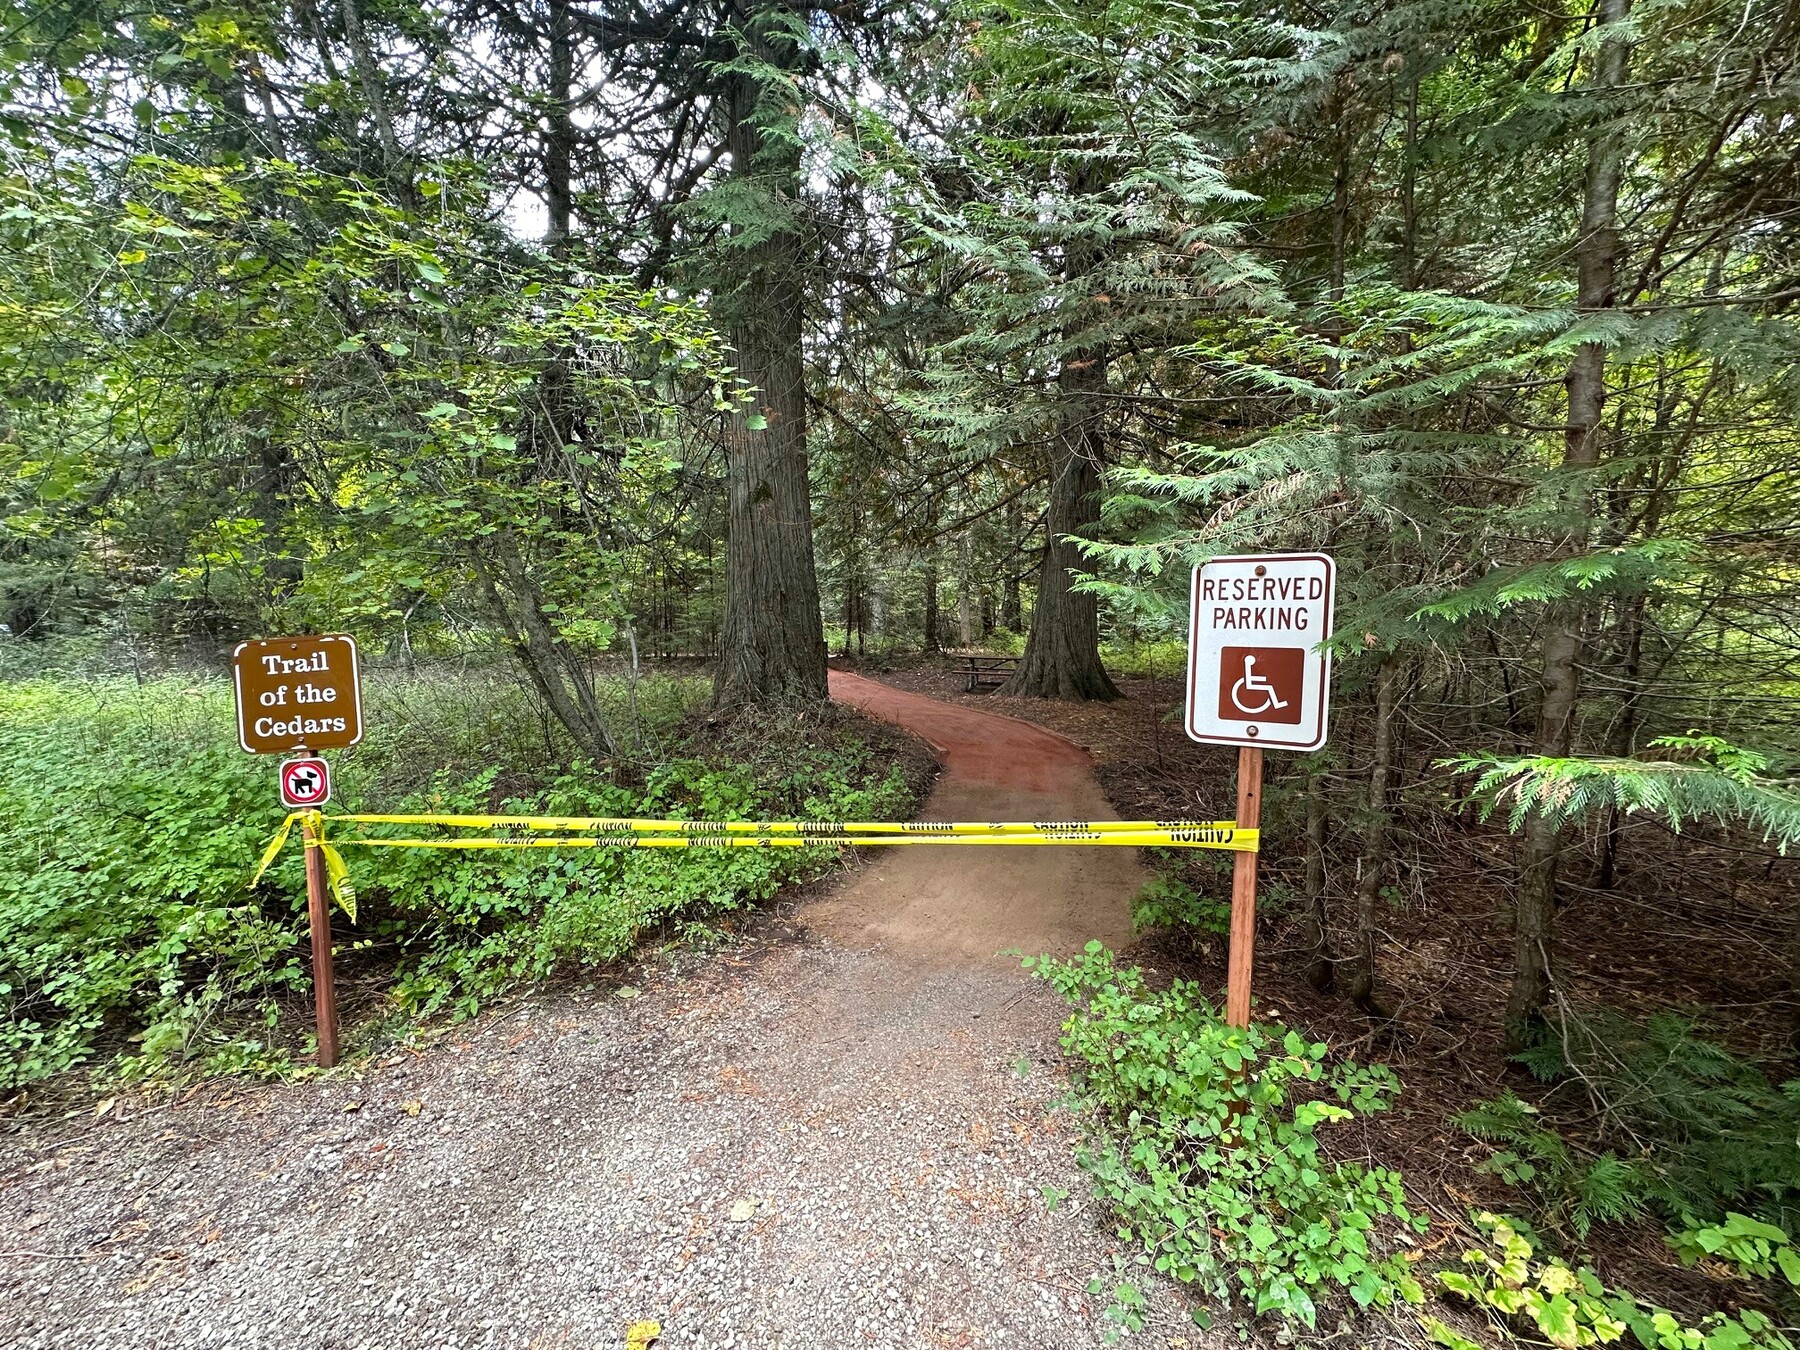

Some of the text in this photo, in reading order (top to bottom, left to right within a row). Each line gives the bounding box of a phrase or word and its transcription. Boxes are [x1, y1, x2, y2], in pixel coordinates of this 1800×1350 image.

[1202, 577, 1323, 601] RESERVED
[1212, 606, 1309, 631] PARKING
[261, 651, 329, 675] Trail
[259, 683, 337, 707] of the
[254, 714, 346, 738] Cedars
[1171, 829, 1233, 844] CAUTION
